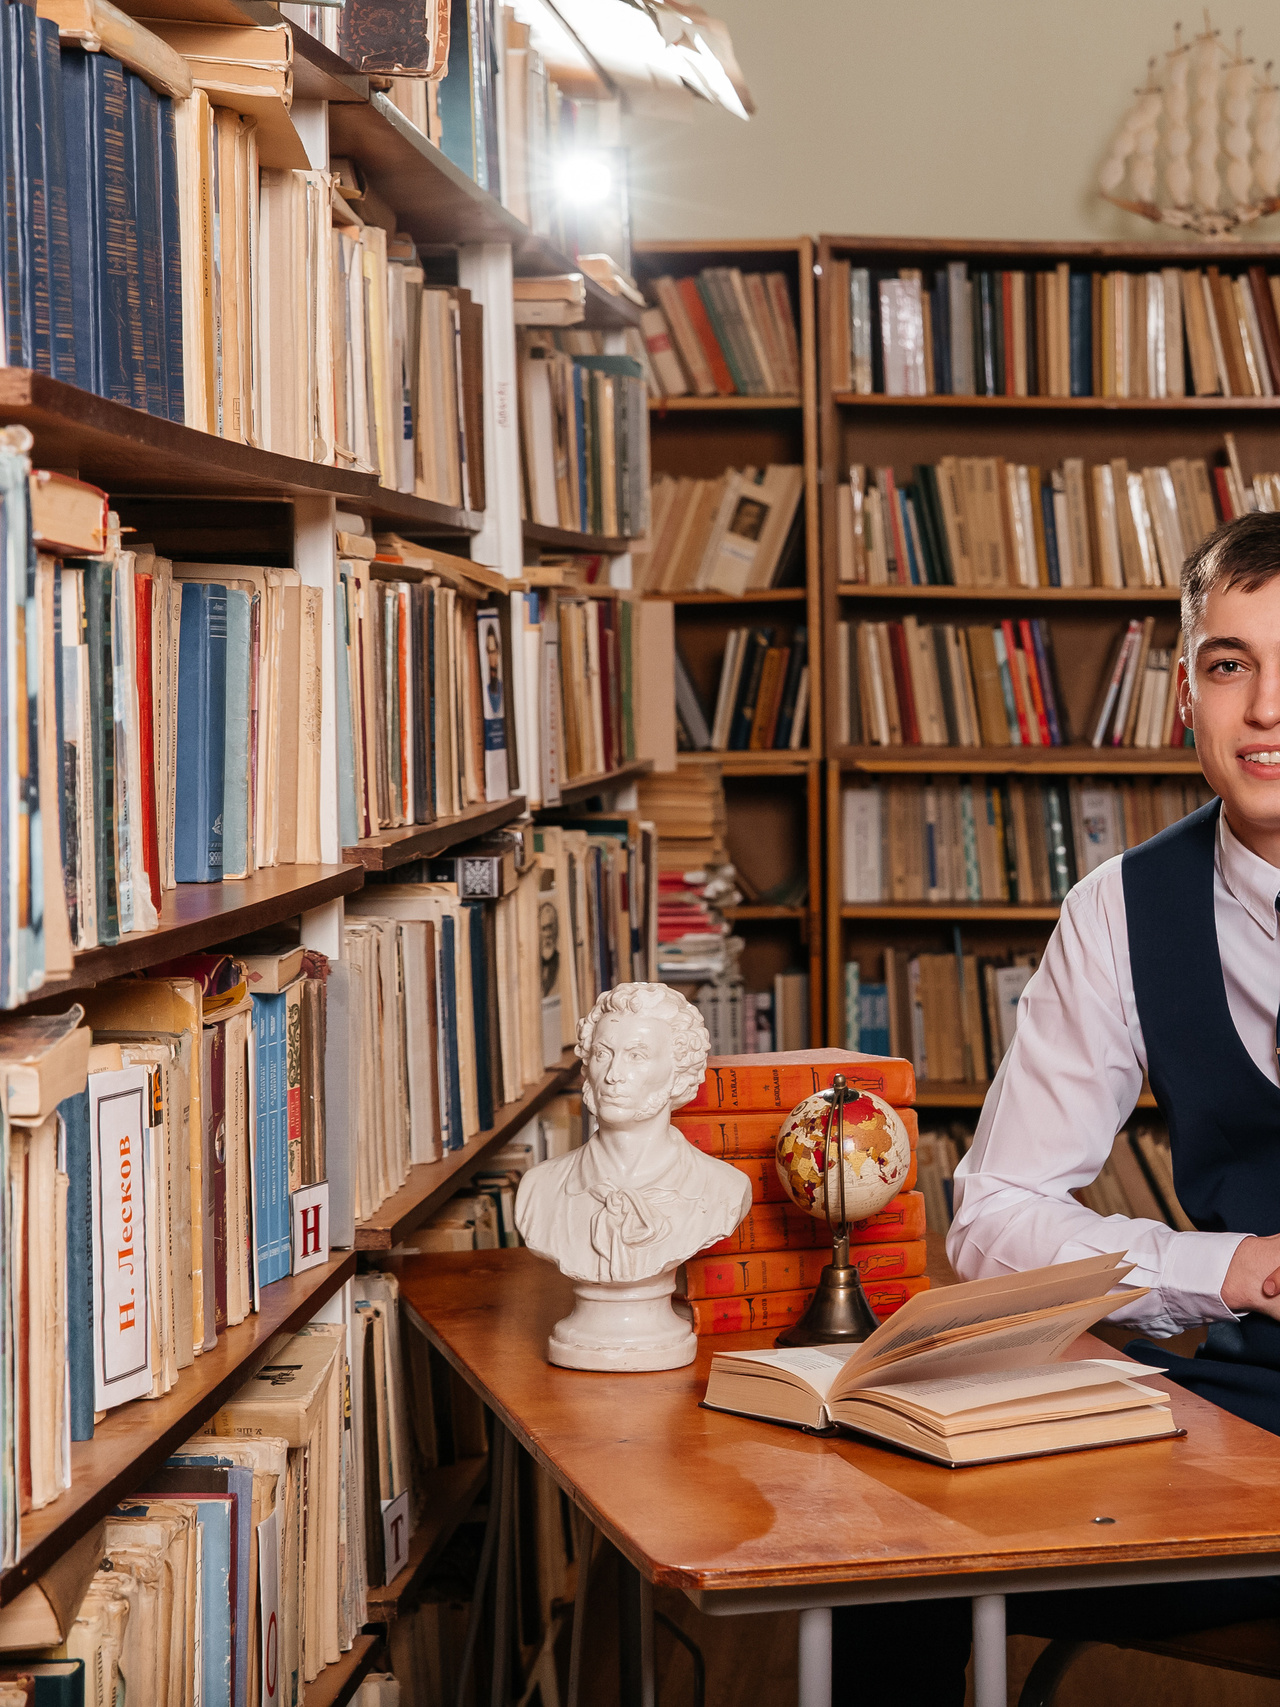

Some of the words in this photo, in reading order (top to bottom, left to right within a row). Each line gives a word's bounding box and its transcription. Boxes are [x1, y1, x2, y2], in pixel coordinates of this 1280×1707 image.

[117, 1134, 134, 1275] Лесков
[300, 1204, 322, 1259] Н
[118, 1287, 136, 1334] Н.
[389, 1512, 404, 1564] Т
